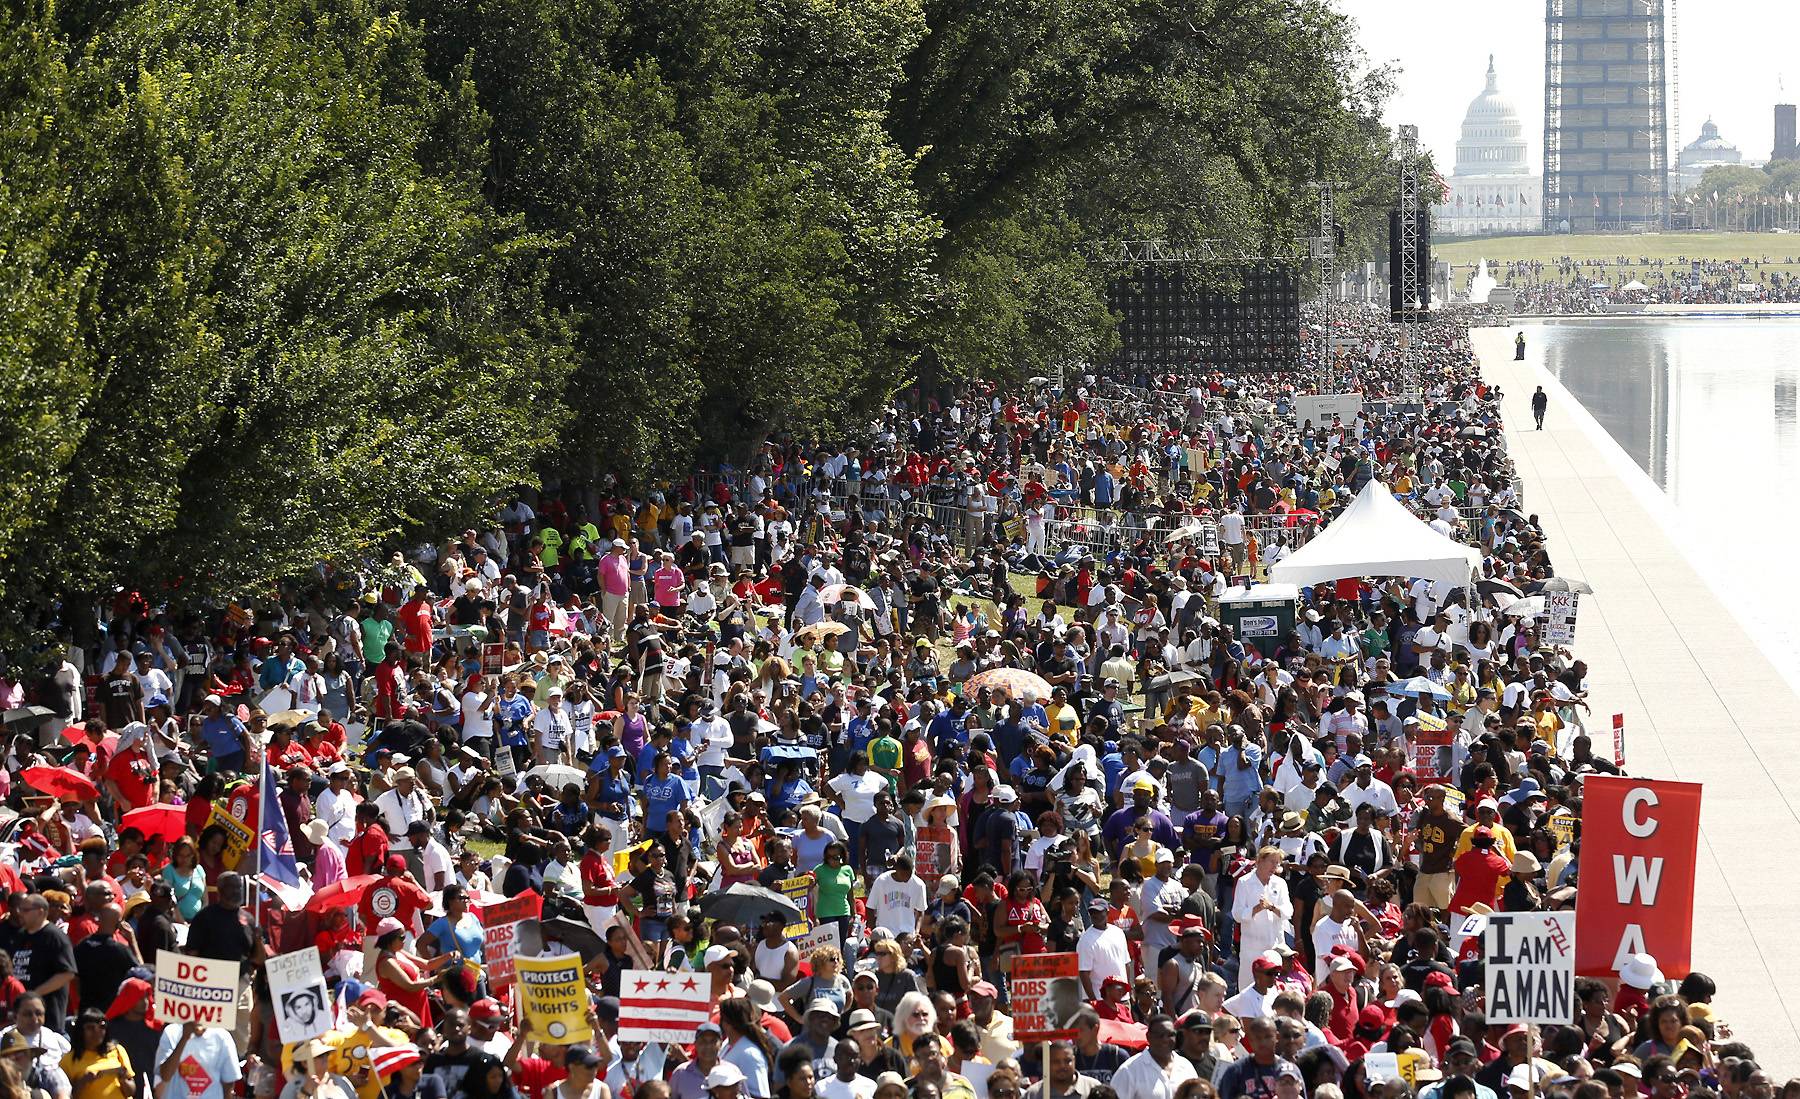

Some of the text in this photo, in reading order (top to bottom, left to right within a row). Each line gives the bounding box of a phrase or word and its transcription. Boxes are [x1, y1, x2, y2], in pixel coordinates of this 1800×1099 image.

[1552, 596, 1569, 606] KKK
[1416, 746, 1435, 756] JOBS
[1416, 757, 1431, 766] NOT
[215, 813, 249, 841] PROTECT
[917, 842, 934, 852] JOBS
[785, 878, 808, 888] NAACP
[485, 925, 514, 944] JOBS
[817, 933, 833, 944] OLD
[1490, 917, 1551, 964] I AM
[1544, 916, 1571, 956] STILL
[486, 943, 508, 960] NOT
[272, 950, 315, 973] JUSTICE
[178, 962, 207, 982] DC
[286, 968, 311, 983] FOR
[523, 971, 575, 984] PROTECT
[159, 980, 232, 1001] STATEHOOD
[528, 987, 576, 998] VOTING
[1013, 981, 1046, 995] JOBS
[1490, 970, 1569, 1018] A MAN
[164, 999, 222, 1023] NOW!
[531, 1001, 579, 1015] RIGHTS
[1013, 998, 1040, 1013] NOT
[1013, 1015, 1046, 1030] WAR
